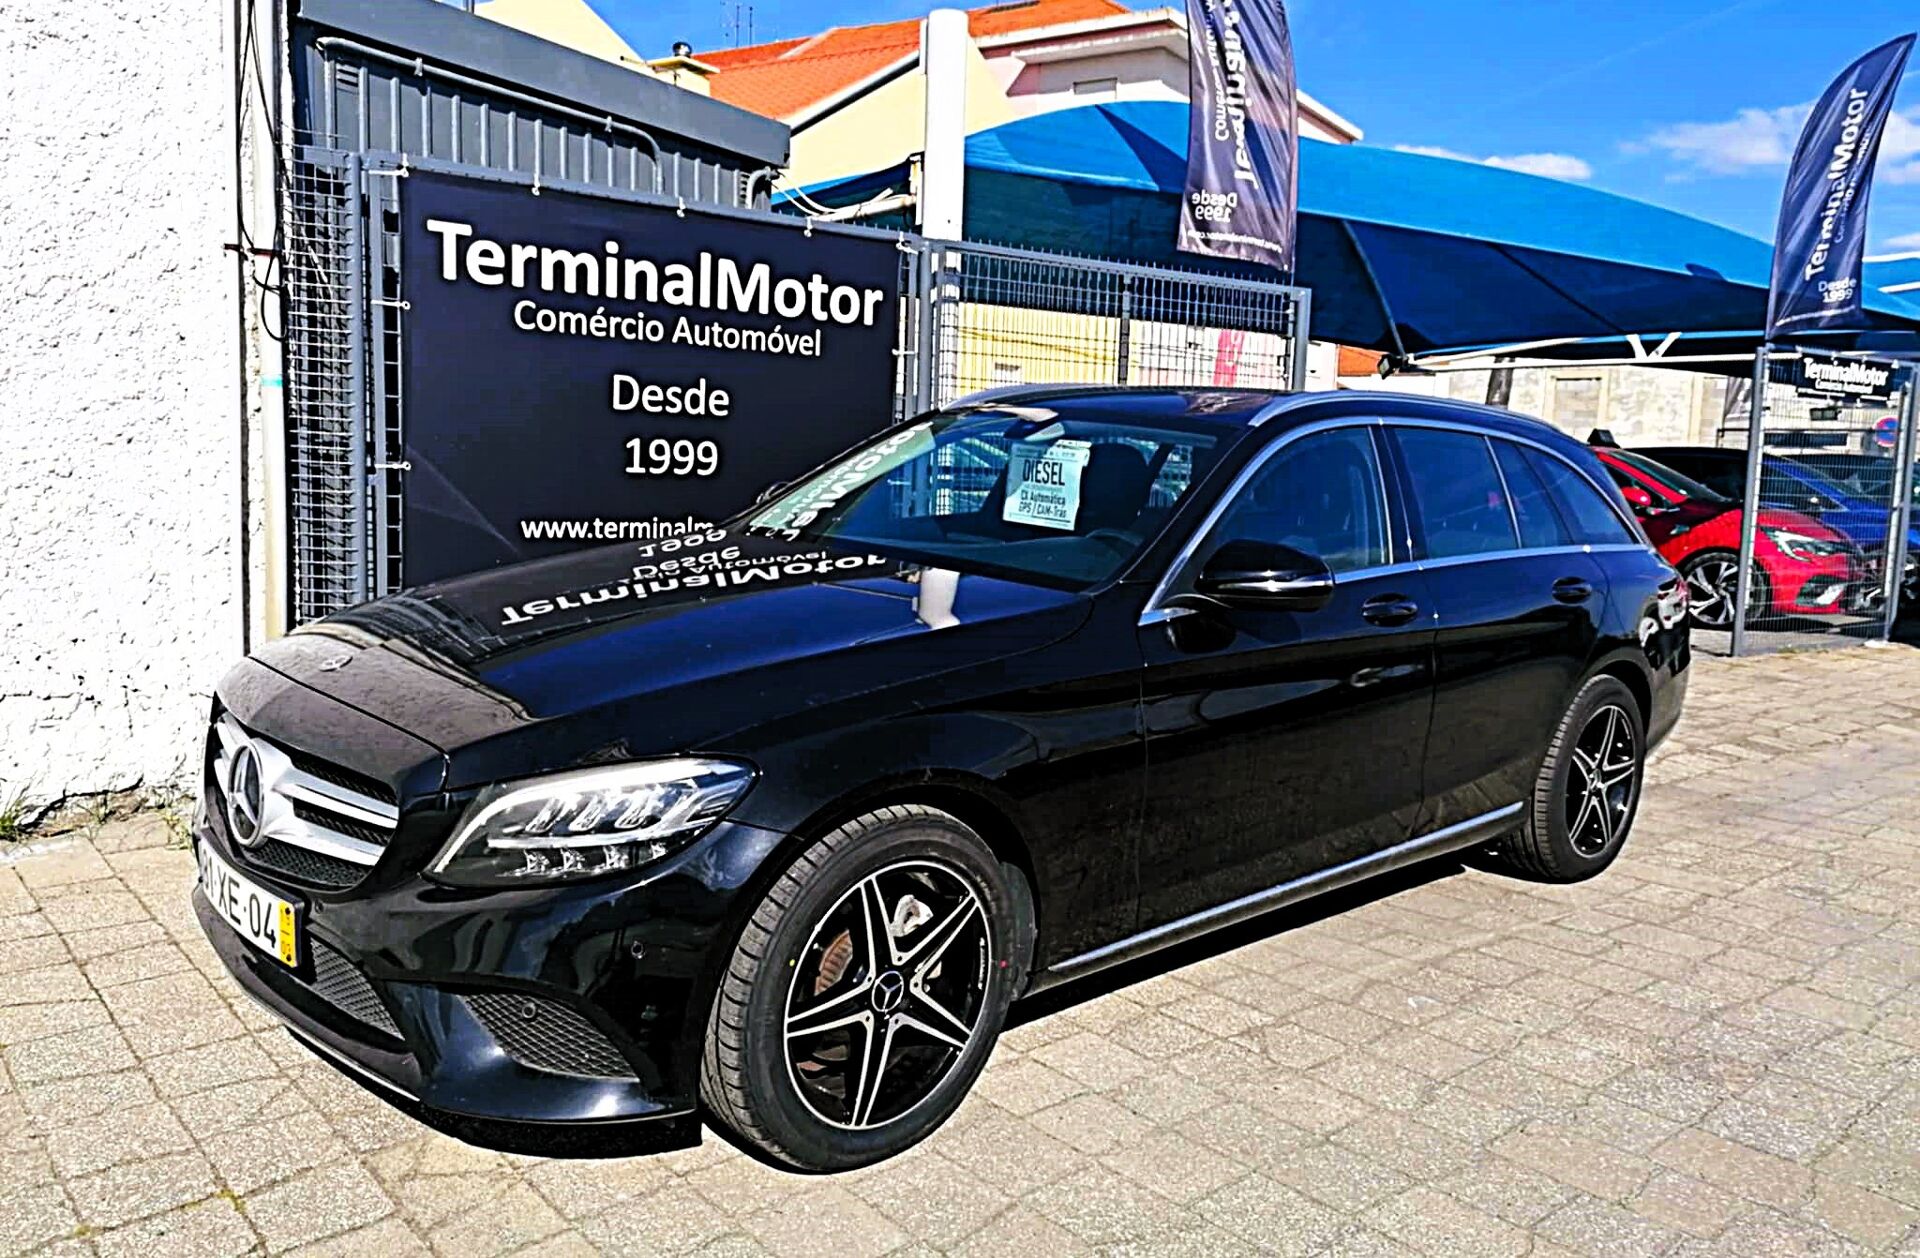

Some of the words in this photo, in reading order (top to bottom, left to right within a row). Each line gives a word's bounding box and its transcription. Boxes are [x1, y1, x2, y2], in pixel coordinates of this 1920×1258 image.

[426, 218, 884, 327] TerminalMotor
[1818, 276, 1857, 292] Desde
[1822, 288, 1853, 303] 1999
[513, 300, 665, 341] Comércio
[671, 315, 822, 357] Automóvel
[1803, 357, 1889, 387] TerminalMotor
[611, 373, 731, 417] Desde
[624, 437, 719, 477] 1999
[1022, 459, 1066, 486] DIESEL
